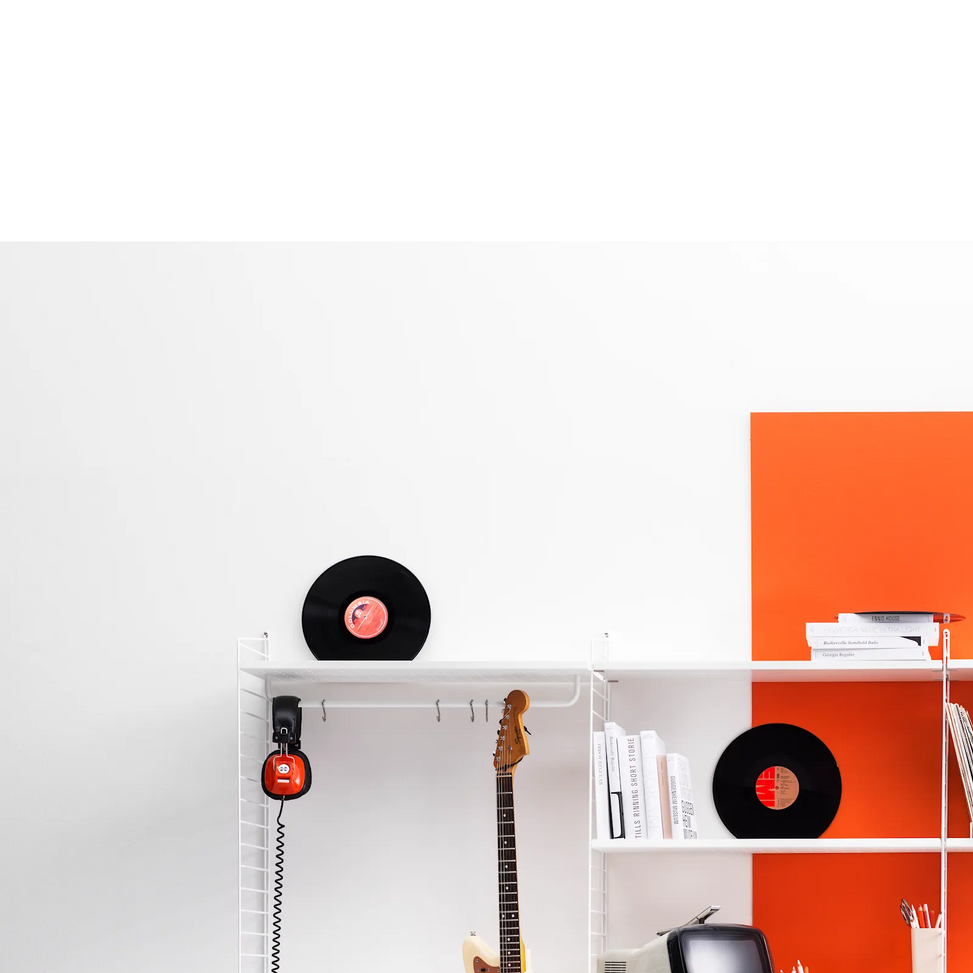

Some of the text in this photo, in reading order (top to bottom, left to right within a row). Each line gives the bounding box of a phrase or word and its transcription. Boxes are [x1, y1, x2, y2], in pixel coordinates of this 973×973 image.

[348, 600, 370, 629] COLUMBIA
[627, 738, 636, 762] STORIE
[629, 765, 638, 787] SHORT
[631, 789, 640, 818] RINNING
